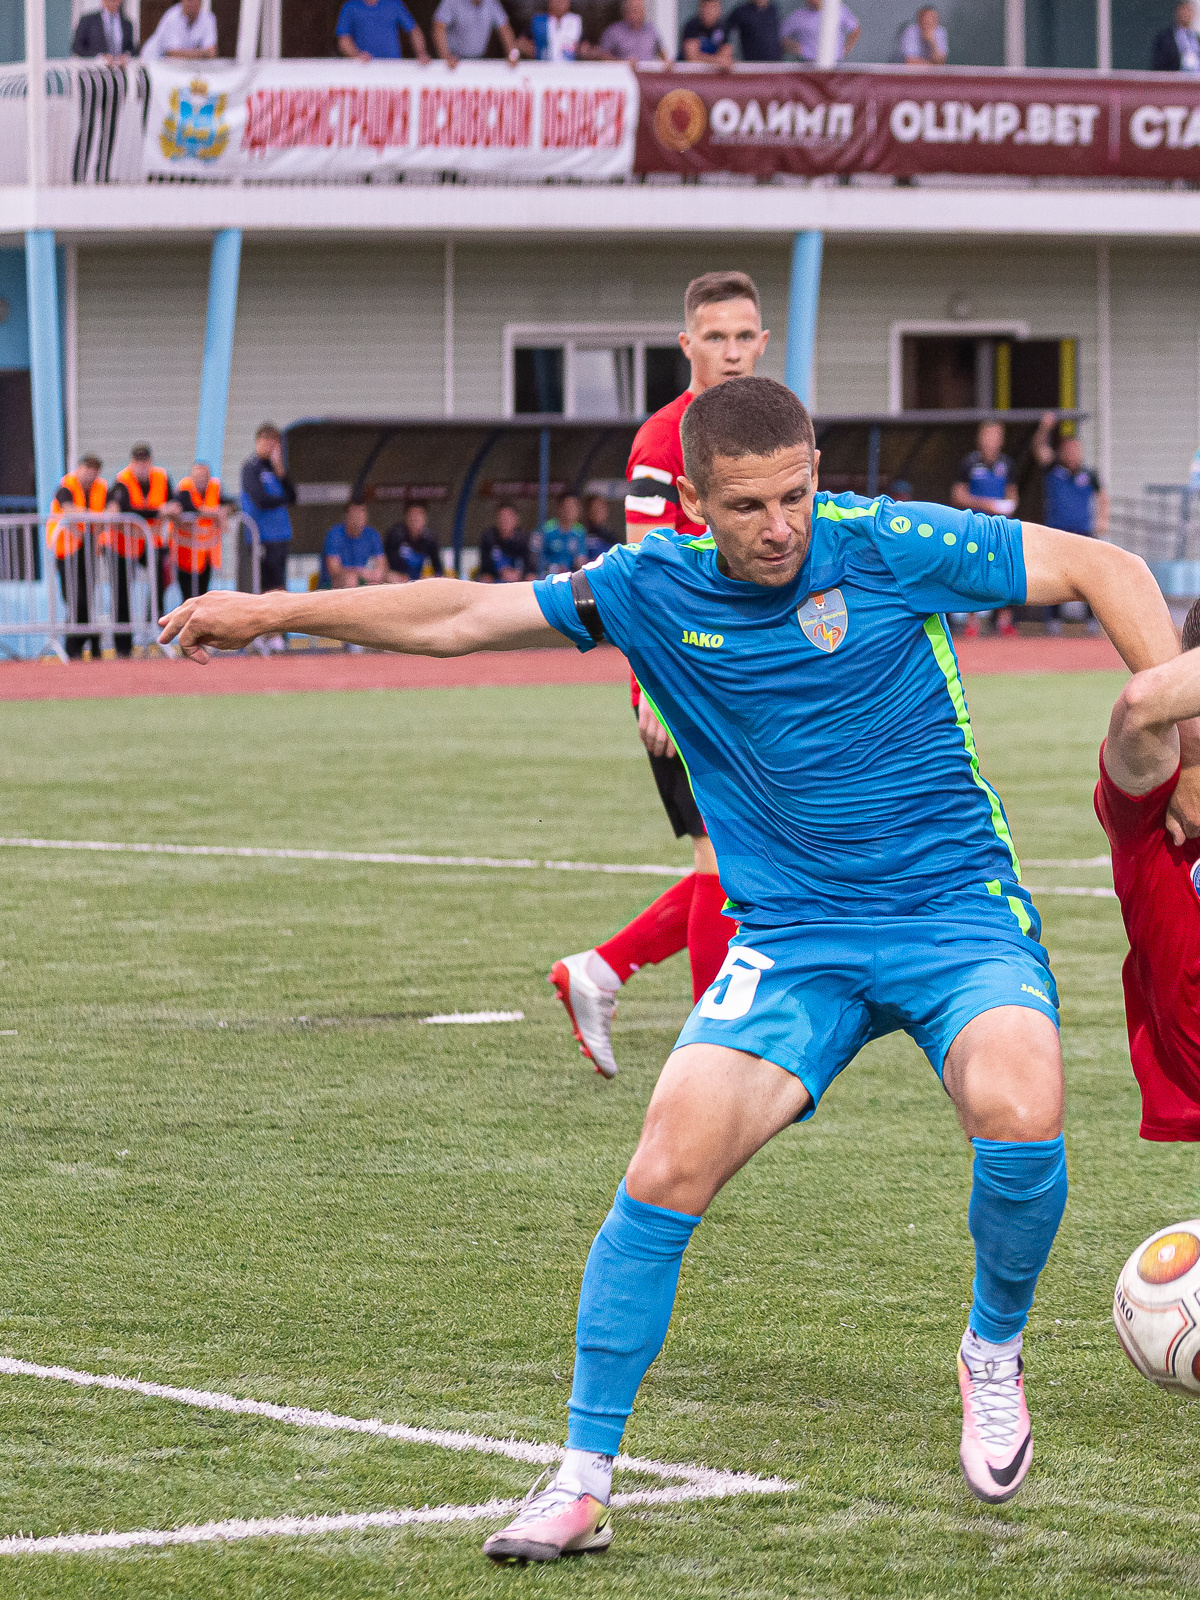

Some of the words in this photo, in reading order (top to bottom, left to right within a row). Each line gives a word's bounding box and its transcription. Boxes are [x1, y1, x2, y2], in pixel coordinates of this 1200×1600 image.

[709, 97, 854, 136] ОЛИМП
[889, 99, 1100, 146] OLIMP.BET
[681, 630, 724, 648] JAKO
[698, 945, 775, 1021] 5
